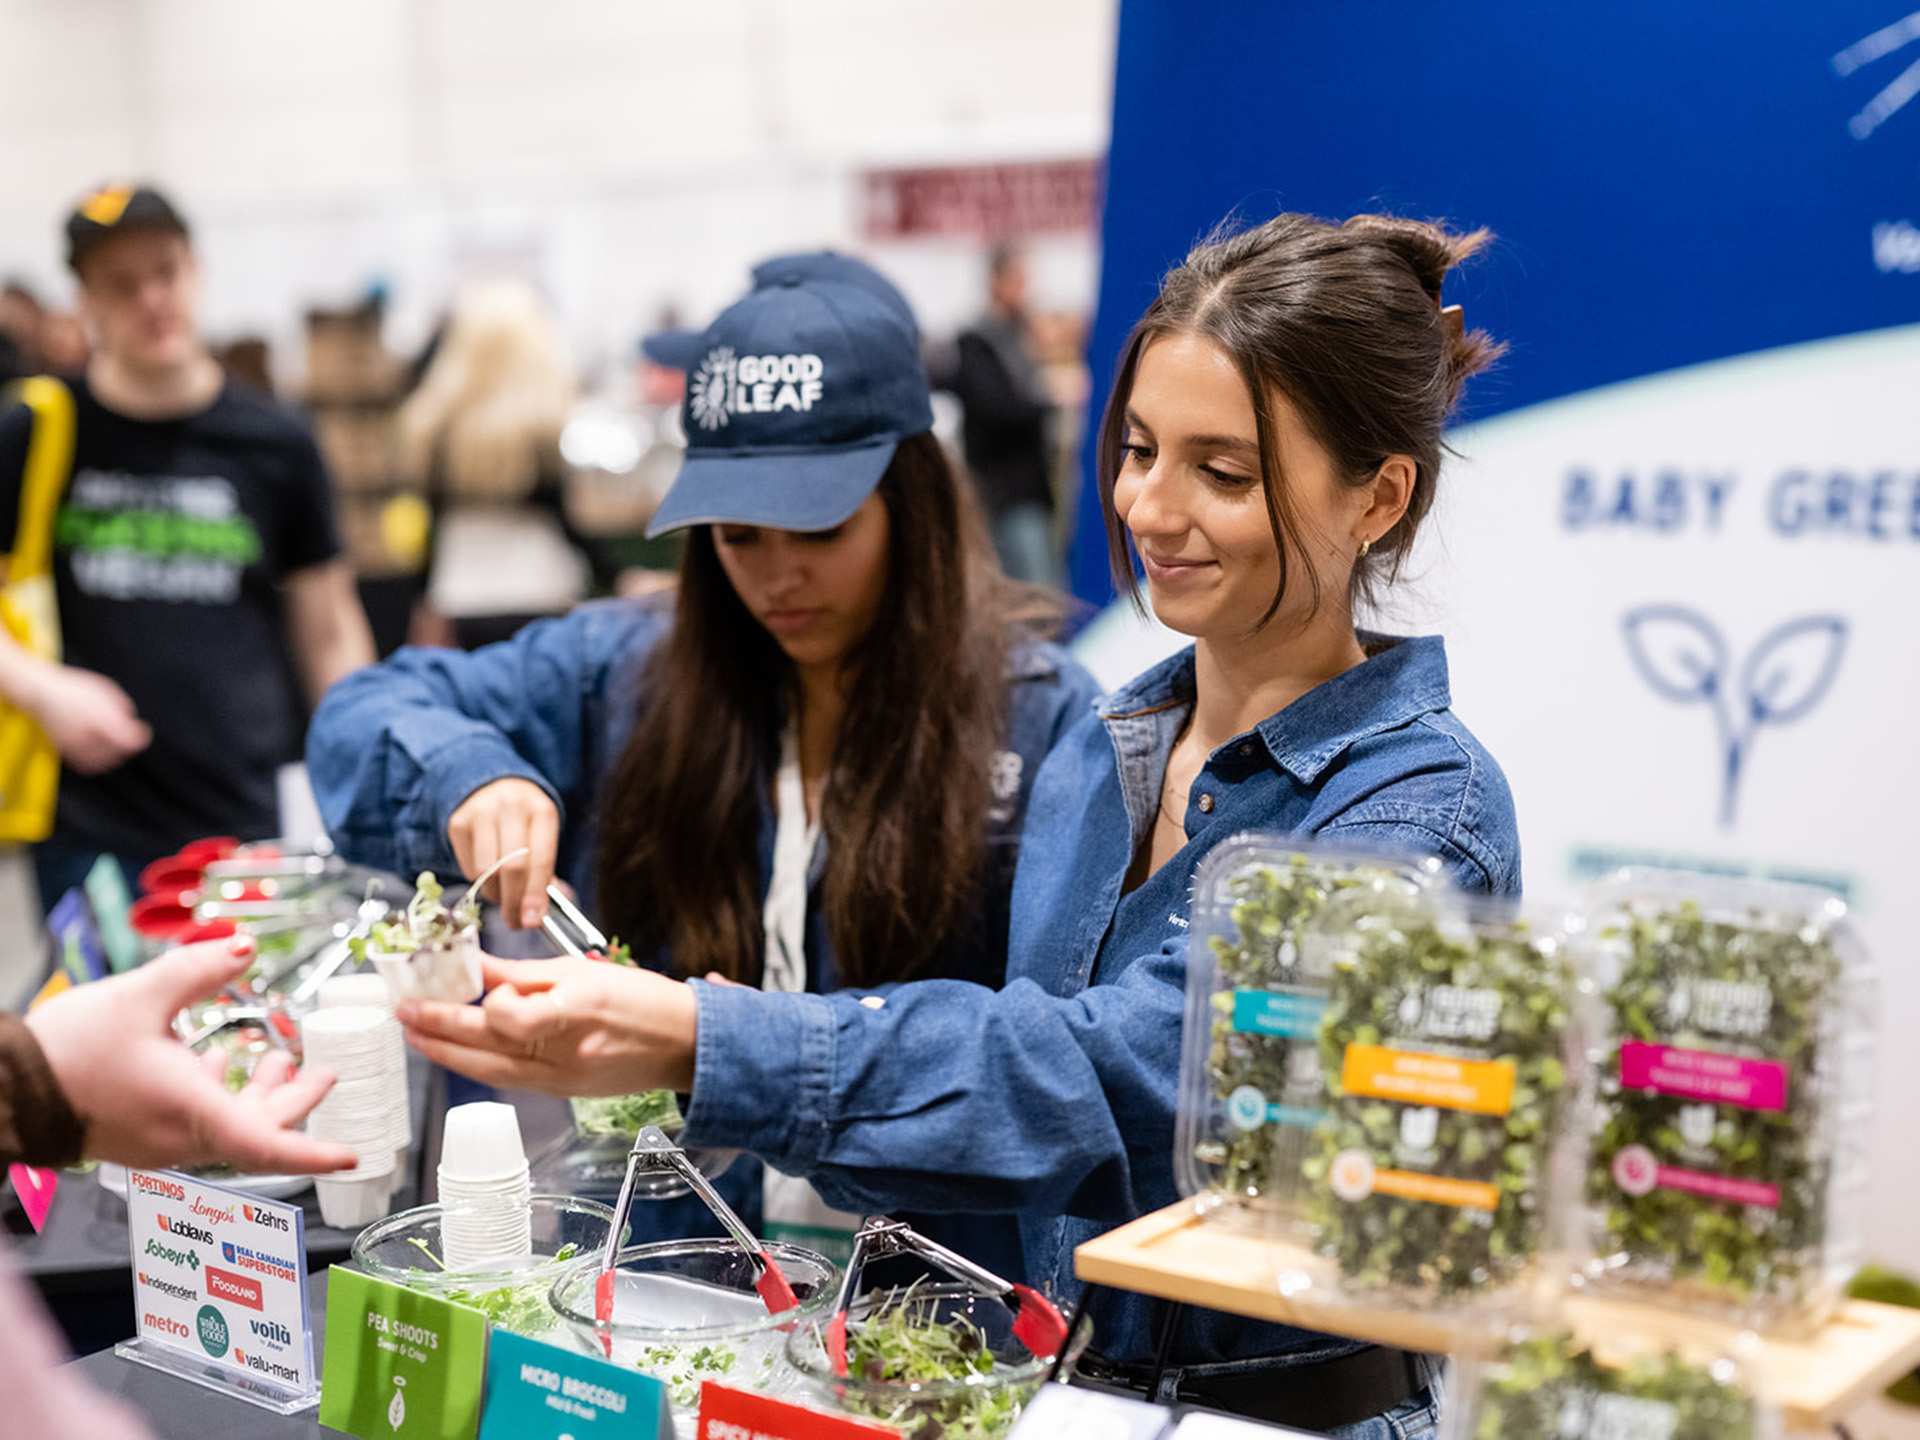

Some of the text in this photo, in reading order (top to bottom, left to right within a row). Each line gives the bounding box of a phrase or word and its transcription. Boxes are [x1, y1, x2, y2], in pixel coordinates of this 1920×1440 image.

[738, 353, 823, 385] GOOD
[736, 381, 823, 413] LEAF
[1560, 466, 1740, 532] BABY
[132, 1172, 185, 1200] FORTINOS
[168, 1217, 214, 1245] Loblaws
[254, 1207, 289, 1232] Zehrs
[236, 1245, 296, 1270] REAL CANADIAN
[237, 1255, 296, 1282] SUPERSTORE
[211, 1275, 257, 1301] FOODLAND
[144, 1312, 190, 1338] metro
[250, 1320, 291, 1346] voilà
[367, 1311, 438, 1350] PEA SHOOTS
[245, 1354, 299, 1384] valu-mart
[521, 1363, 627, 1414] MICRO BROCCOLI
